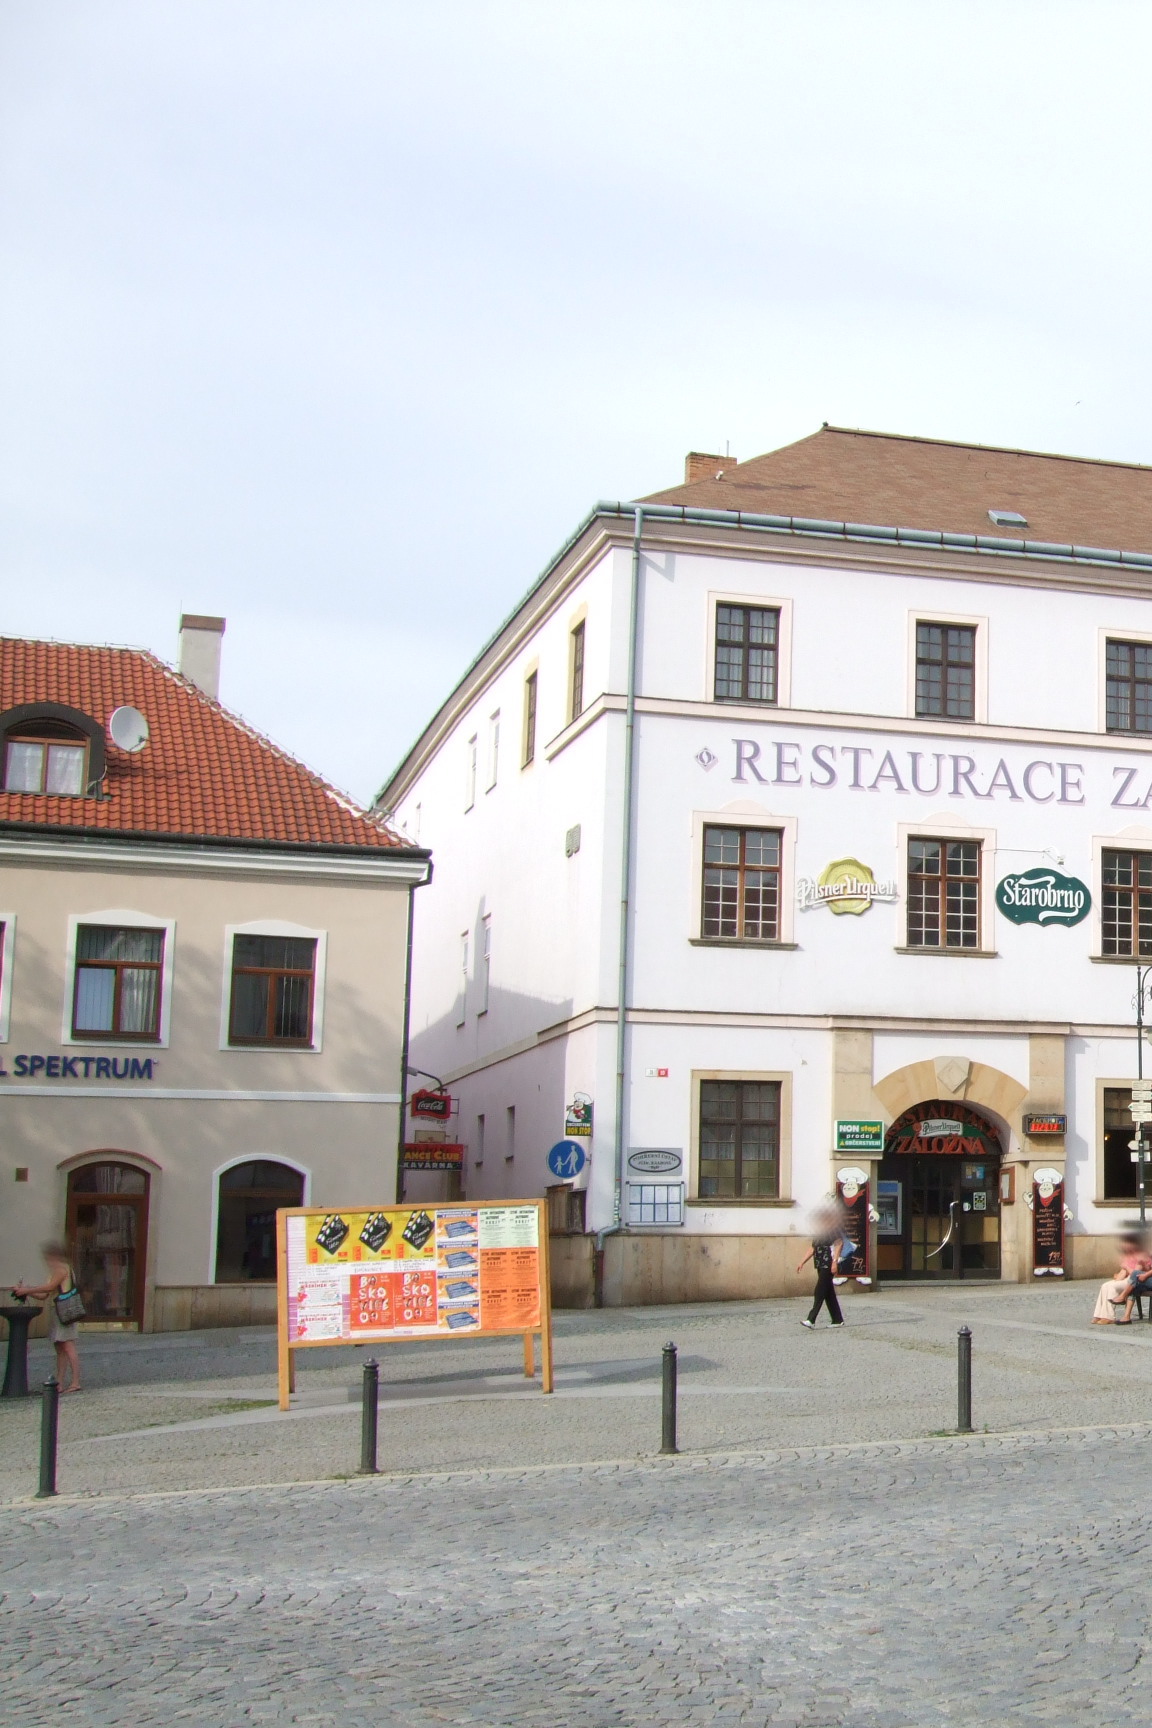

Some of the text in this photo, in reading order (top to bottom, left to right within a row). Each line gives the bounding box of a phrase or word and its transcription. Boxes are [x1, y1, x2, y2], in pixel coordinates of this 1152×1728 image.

[731, 738, 1086, 806] RESTAURACE
[794, 873, 896, 912] Pilsner Urquell
[1002, 876, 1085, 922] Starobrno
[14, 1054, 153, 1080] SPEKTRUM
[417, 1100, 445, 1111] Coca-Cola
[839, 1124, 881, 1133] NON stop!
[885, 1102, 1000, 1142] RESTAURACE
[896, 1132, 988, 1155] ZÁLOŽNA
